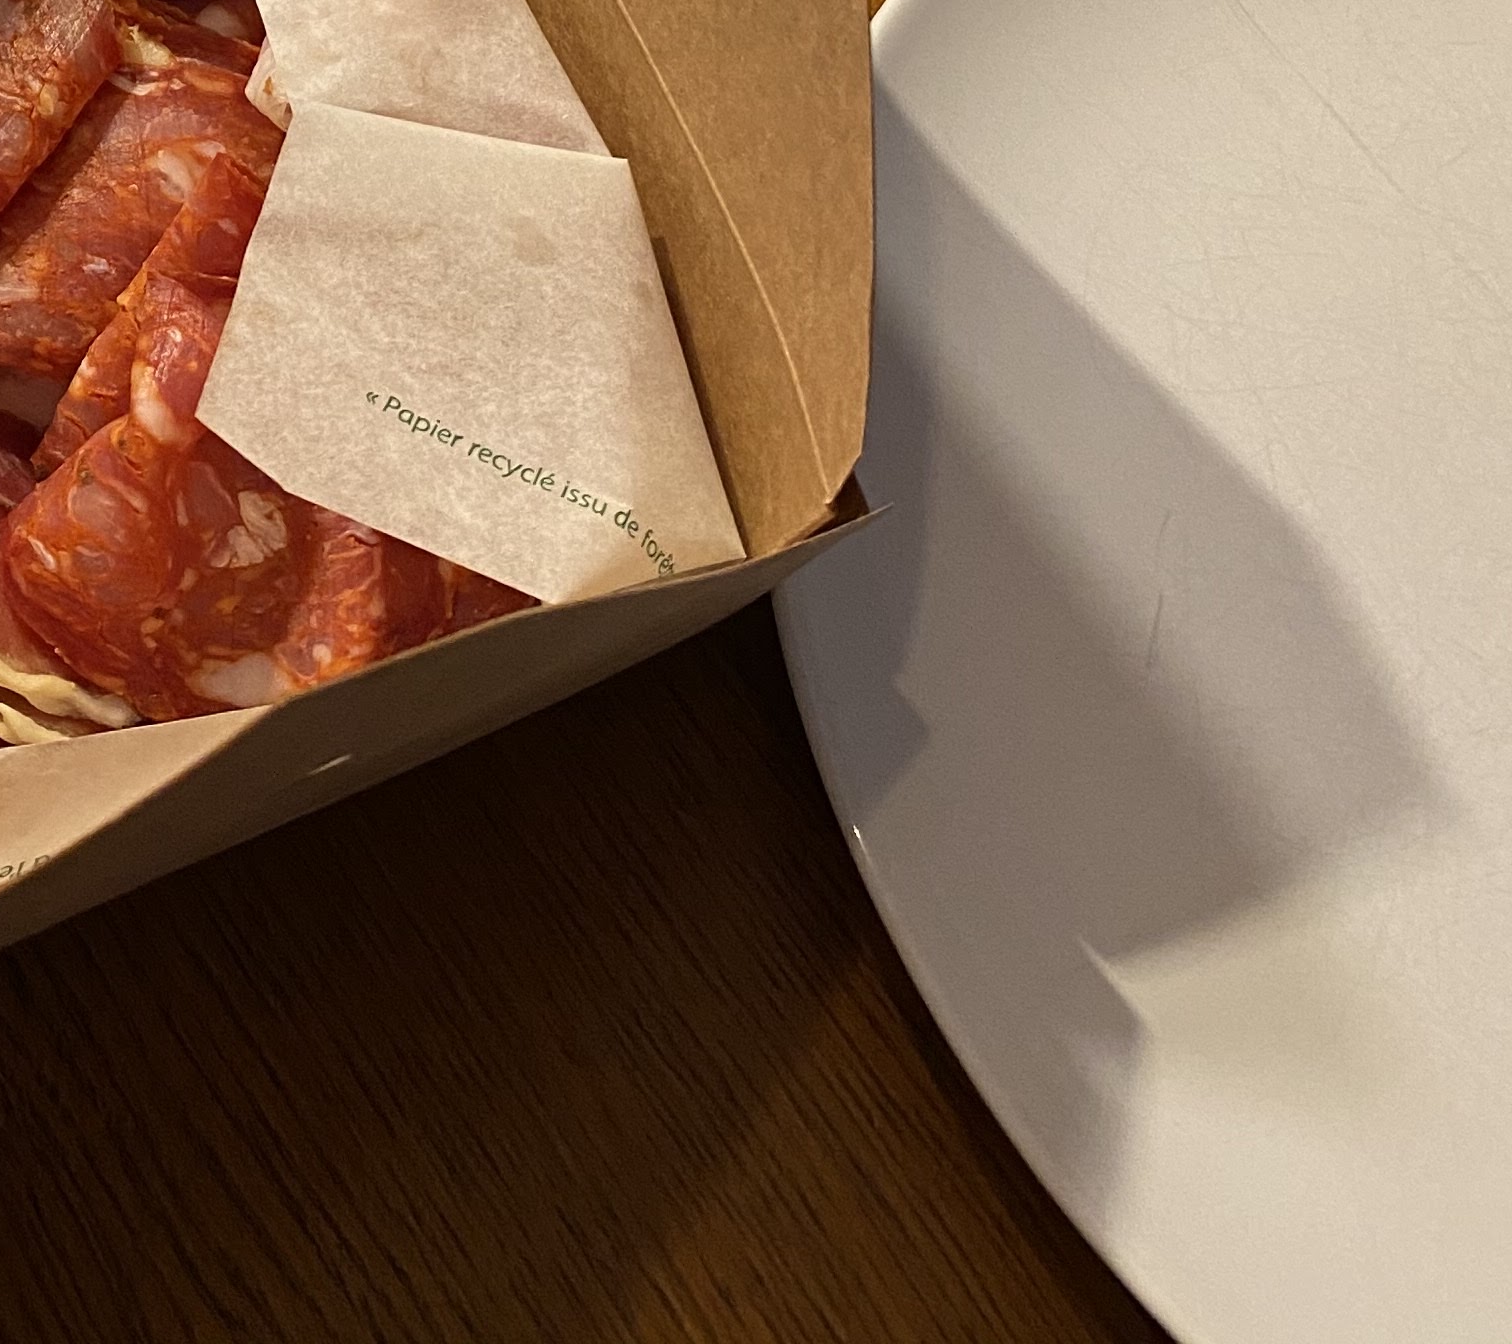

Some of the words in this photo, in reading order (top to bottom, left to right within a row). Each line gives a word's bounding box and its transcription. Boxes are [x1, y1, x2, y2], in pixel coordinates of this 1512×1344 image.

[382, 394, 465, 448] Papier
[467, 441, 557, 493] recyclé
[560, 479, 609, 518] issu
[613, 507, 640, 540] de
